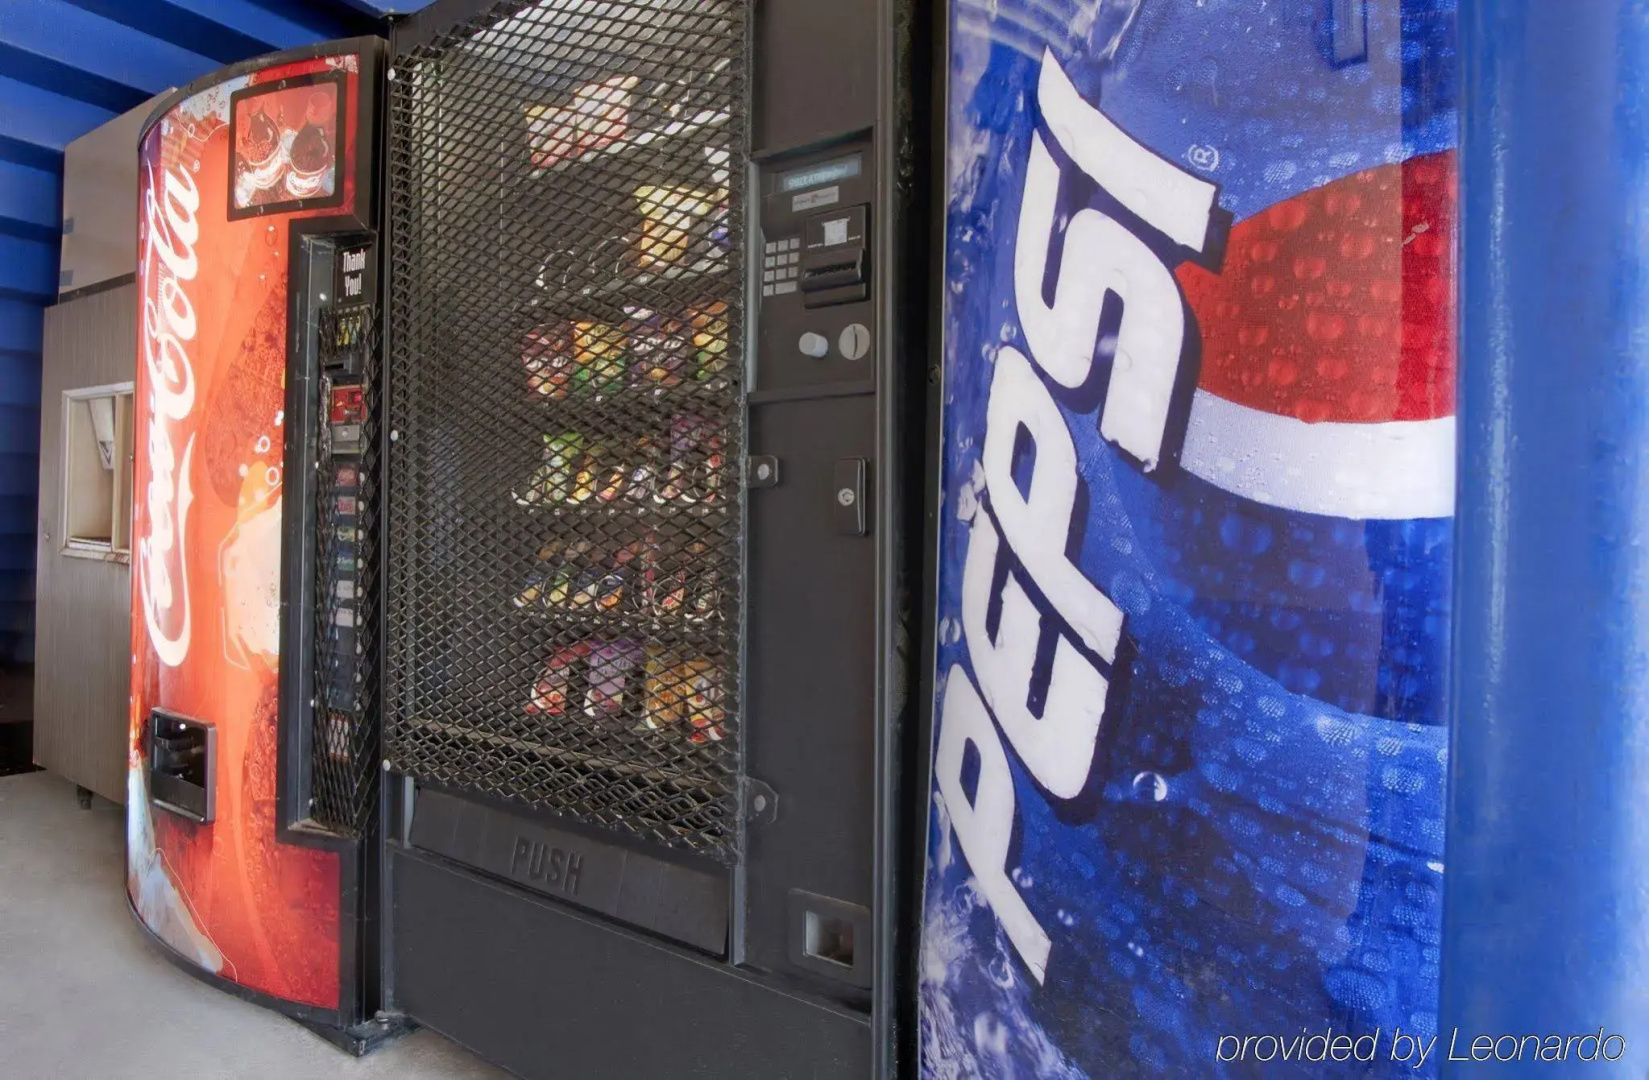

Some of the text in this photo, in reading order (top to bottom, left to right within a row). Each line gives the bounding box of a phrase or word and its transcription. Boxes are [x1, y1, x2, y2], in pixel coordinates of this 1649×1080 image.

[343, 248, 366, 273] Thank
[345, 273, 362, 297] You!
[139, 158, 200, 667] Coca-Cola
[934, 47, 1217, 985] PEPSI
[509, 834, 583, 896] PUSH
